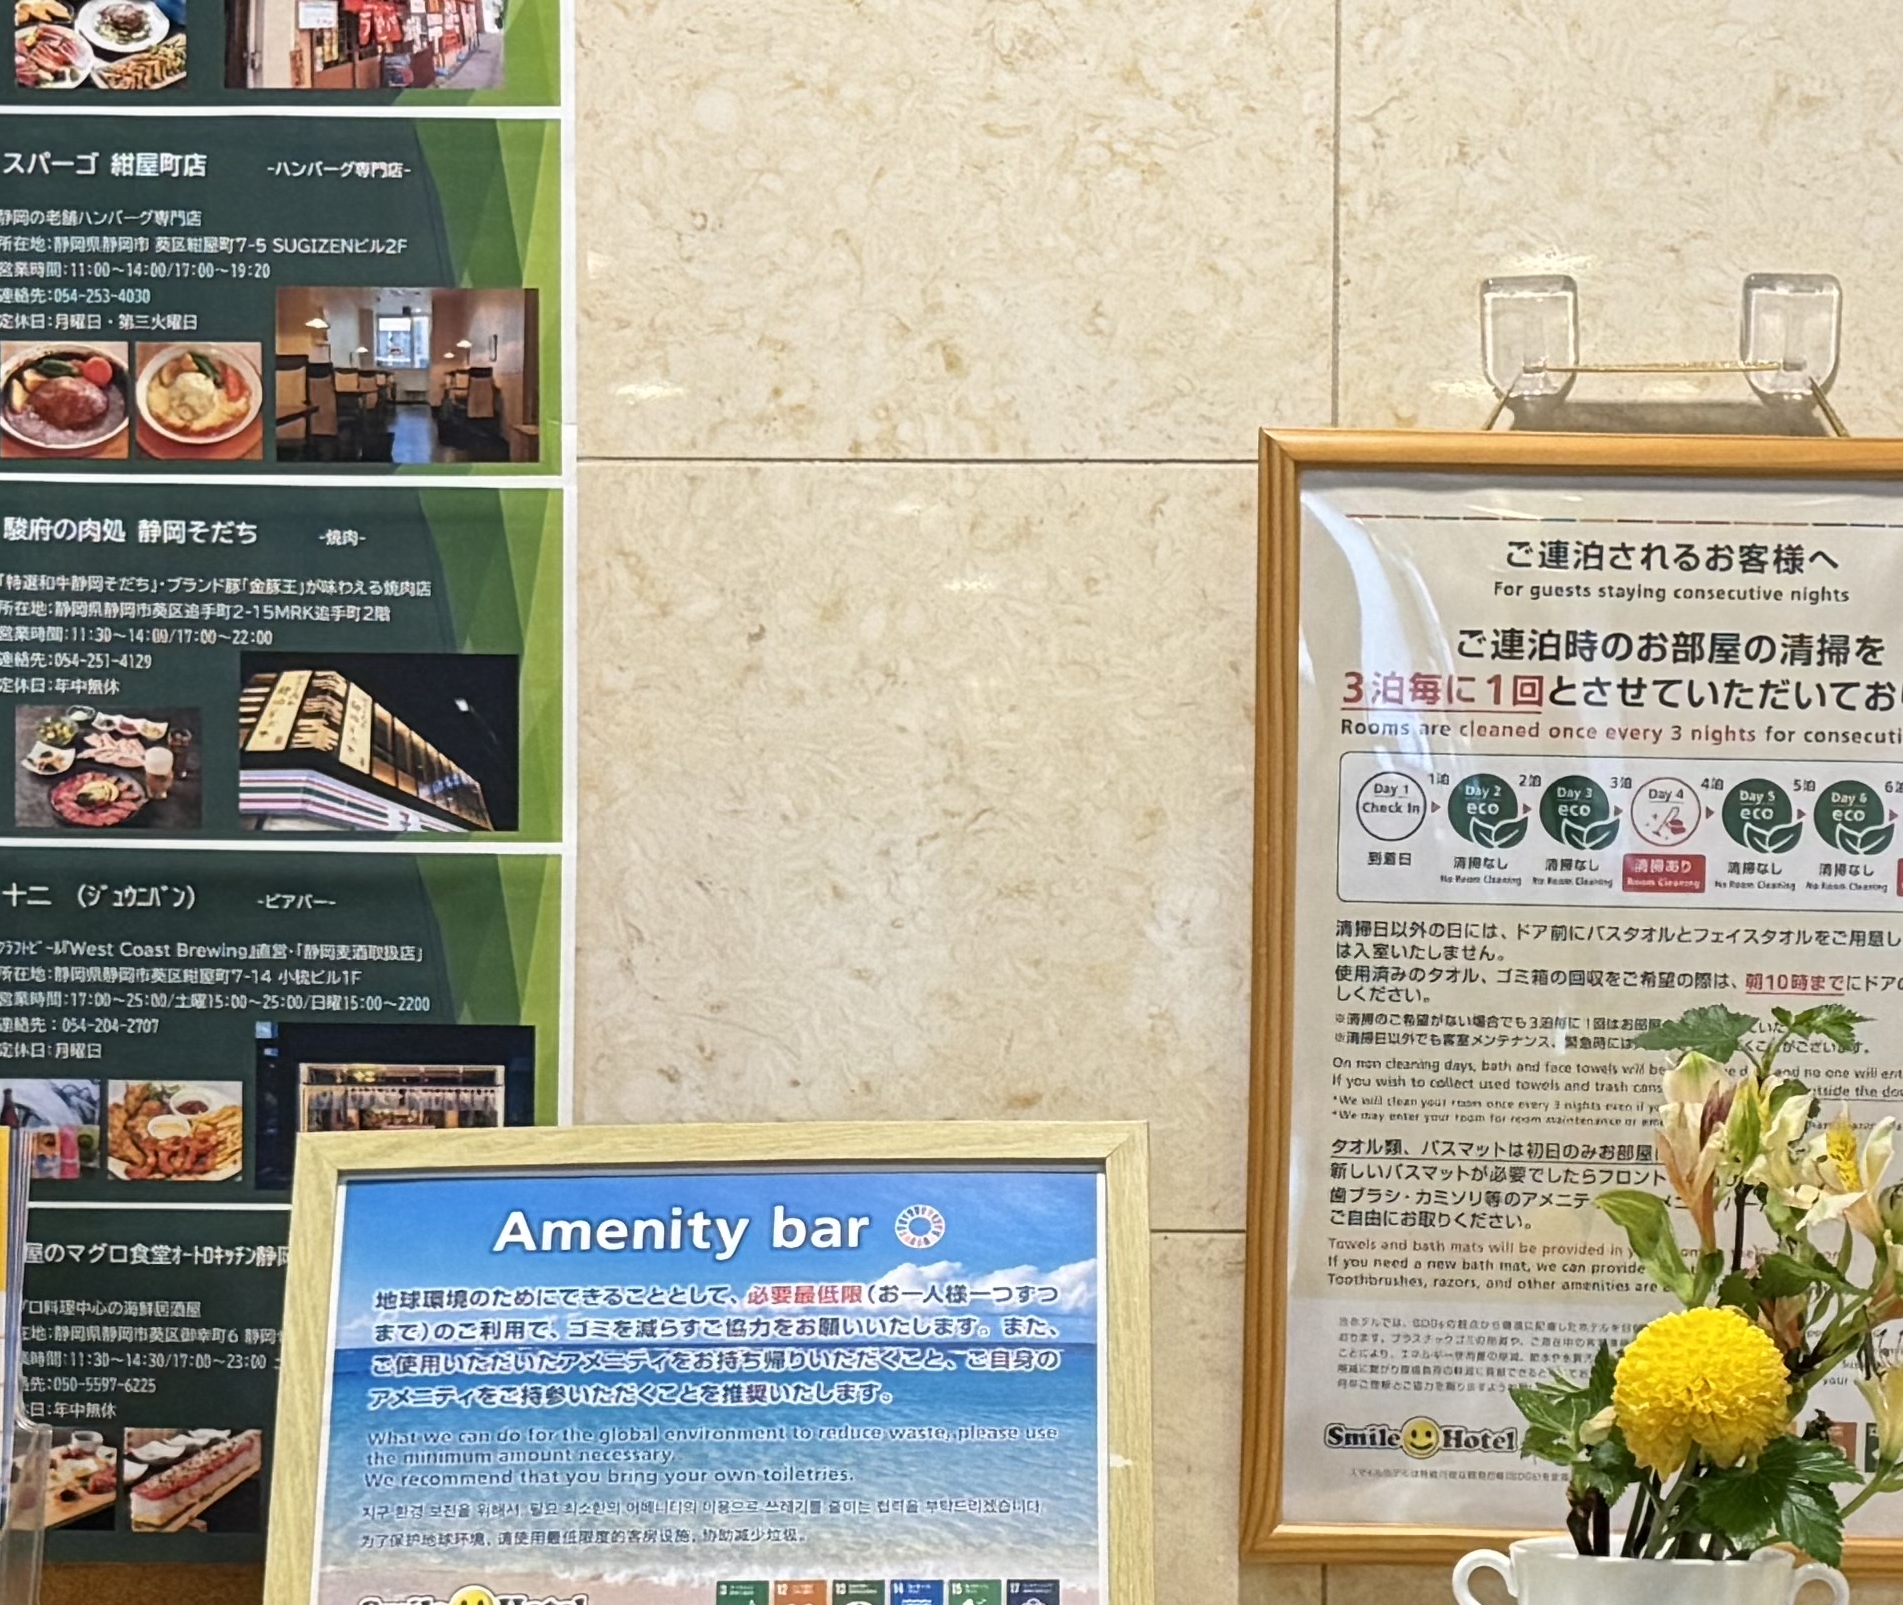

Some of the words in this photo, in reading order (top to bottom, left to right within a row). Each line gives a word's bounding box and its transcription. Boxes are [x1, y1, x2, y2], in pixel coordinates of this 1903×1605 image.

[3, 153, 98, 177] スパーゴ
[111, 152, 207, 178] 紺屋町店
[4, 517, 125, 543] 駿府の肉処
[138, 518, 258, 545] 静岡そだち
[1506, 540, 1839, 575] ご連泊されるお客様へ
[1494, 581, 1523, 596] For
[1530, 585, 1591, 600] guests
[1599, 584, 1666, 603] staying
[1674, 586, 1783, 601] consecutive
[1791, 586, 1849, 605] nights
[1458, 629, 1884, 668] ご連泊時のお部屋の清掃を
[1342, 719, 1408, 735] Rooms
[1422, 724, 1451, 737] are
[1460, 720, 1540, 738] cleaned
[1549, 726, 1597, 739] once
[1606, 728, 1663, 744] every
[1672, 725, 1682, 741] 3
[1691, 725, 1756, 746] nights
[1766, 725, 1795, 742] for
[1467, 803, 1499, 815] eco
[1558, 804, 1590, 817] eco
[3, 883, 52, 907] 十二
[1336, 943, 1504, 961] は入室いたしません。
[1337, 986, 1430, 1002] しください。
[1330, 1211, 1532, 1230] ご自由にお取りください。
[493, 1206, 749, 1261] Amenity
[772, 1205, 870, 1250] bar
[1327, 1426, 1401, 1449] Smile
[1443, 1426, 1517, 1450] Hotel
